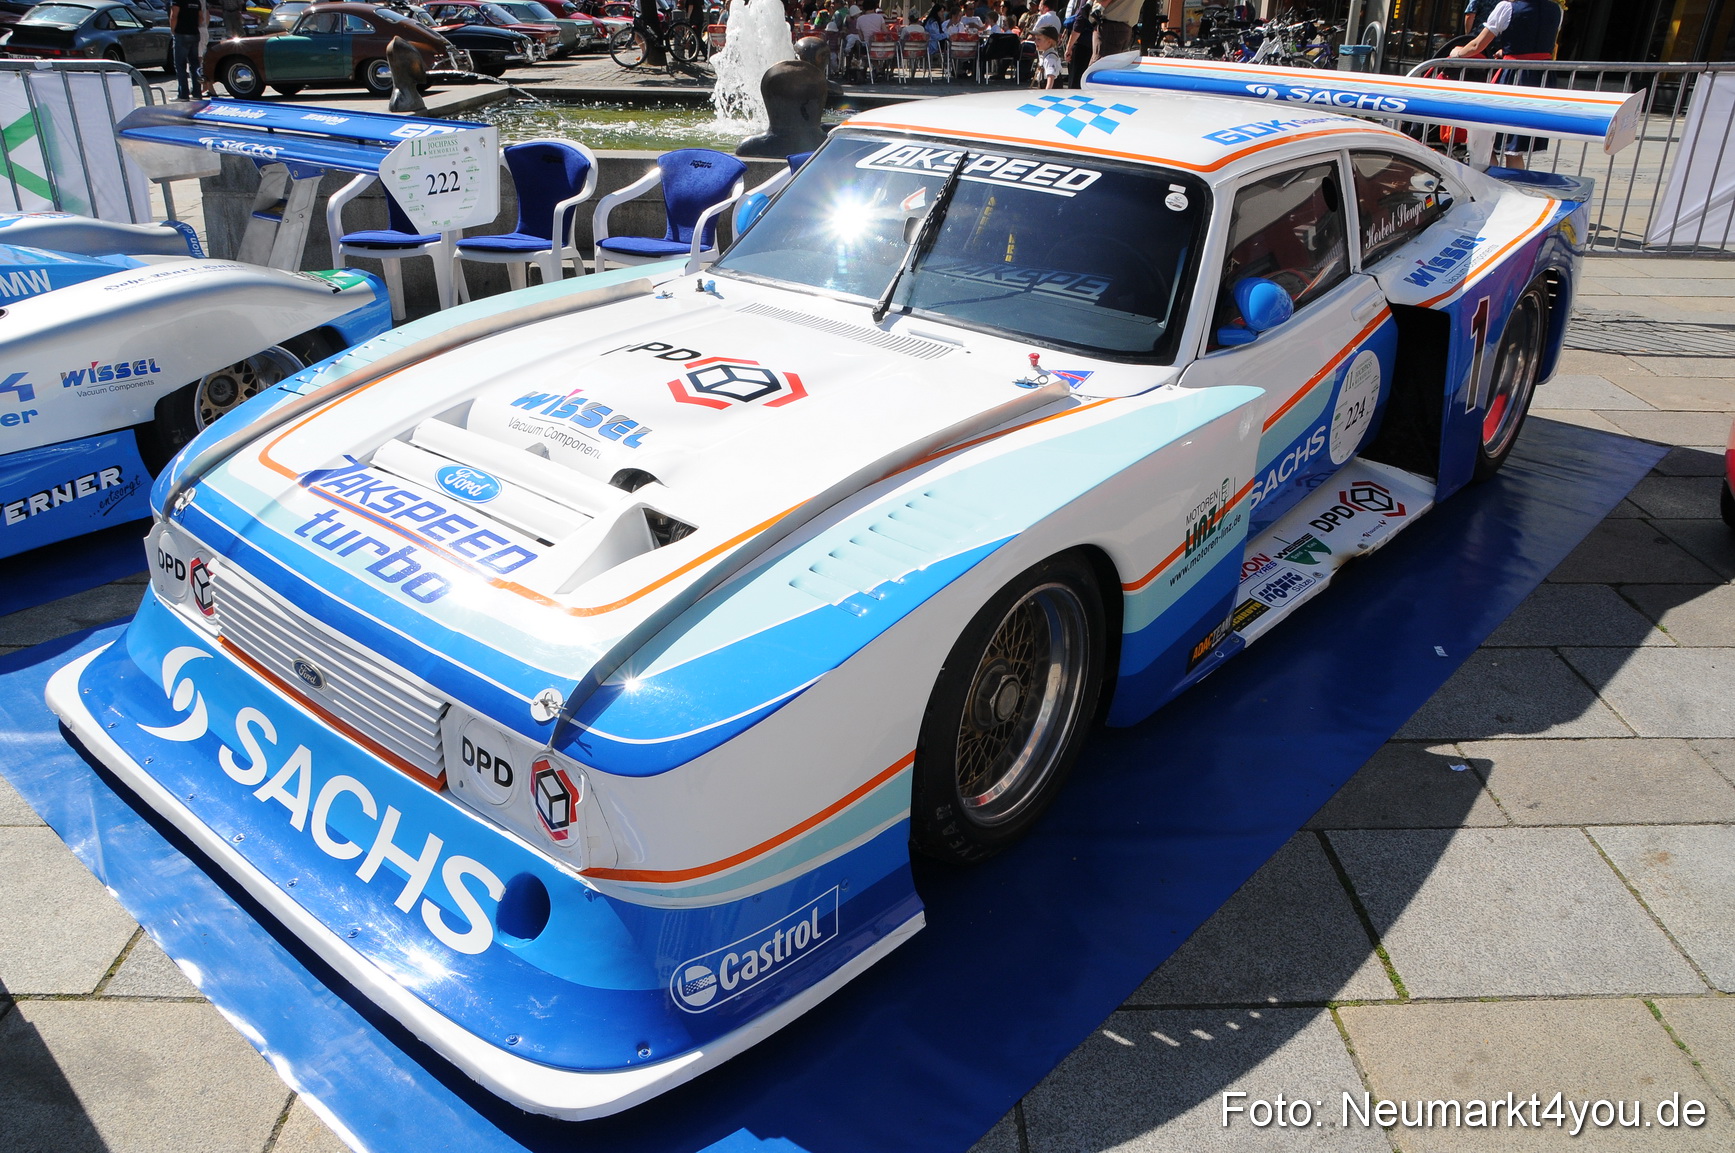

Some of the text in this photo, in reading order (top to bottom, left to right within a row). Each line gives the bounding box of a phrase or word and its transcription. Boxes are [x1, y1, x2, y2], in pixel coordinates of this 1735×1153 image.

[1286, 87, 1409, 113] SACHS
[410, 140, 427, 158] 11.
[427, 139, 459, 150] JOCHPASS
[425, 170, 461, 196] 222
[855, 142, 1103, 198] ZAKSPEED
[1365, 212, 1396, 250] Herbert
[1402, 234, 1488, 288] WISSEL
[0, 268, 52, 298] MW
[60, 357, 161, 389] WISSEL
[1465, 295, 1491, 415] 1
[76, 379, 155, 398] Vacuum Components
[507, 416, 545, 437] Vacuum
[509, 388, 653, 450] WISSEL
[1343, 396, 1367, 432] 224
[443, 468, 493, 497] Ford
[1249, 425, 1327, 511] SACHS
[0, 465, 122, 527] ERNER
[1185, 488, 1219, 526] MOTOREN
[1308, 504, 1356, 533] DPD
[157, 546, 188, 582] DPD
[293, 508, 453, 605] turbo
[1169, 513, 1242, 587] www.motoren-linz.de
[1273, 532, 1314, 560] WEISS
[1253, 560, 1278, 579] TYRES
[1291, 578, 1313, 593] Sitze
[297, 662, 318, 686] Ford
[462, 735, 514, 788] DPD
[217, 706, 508, 955] SACHS
[718, 906, 822, 991] Castrol
